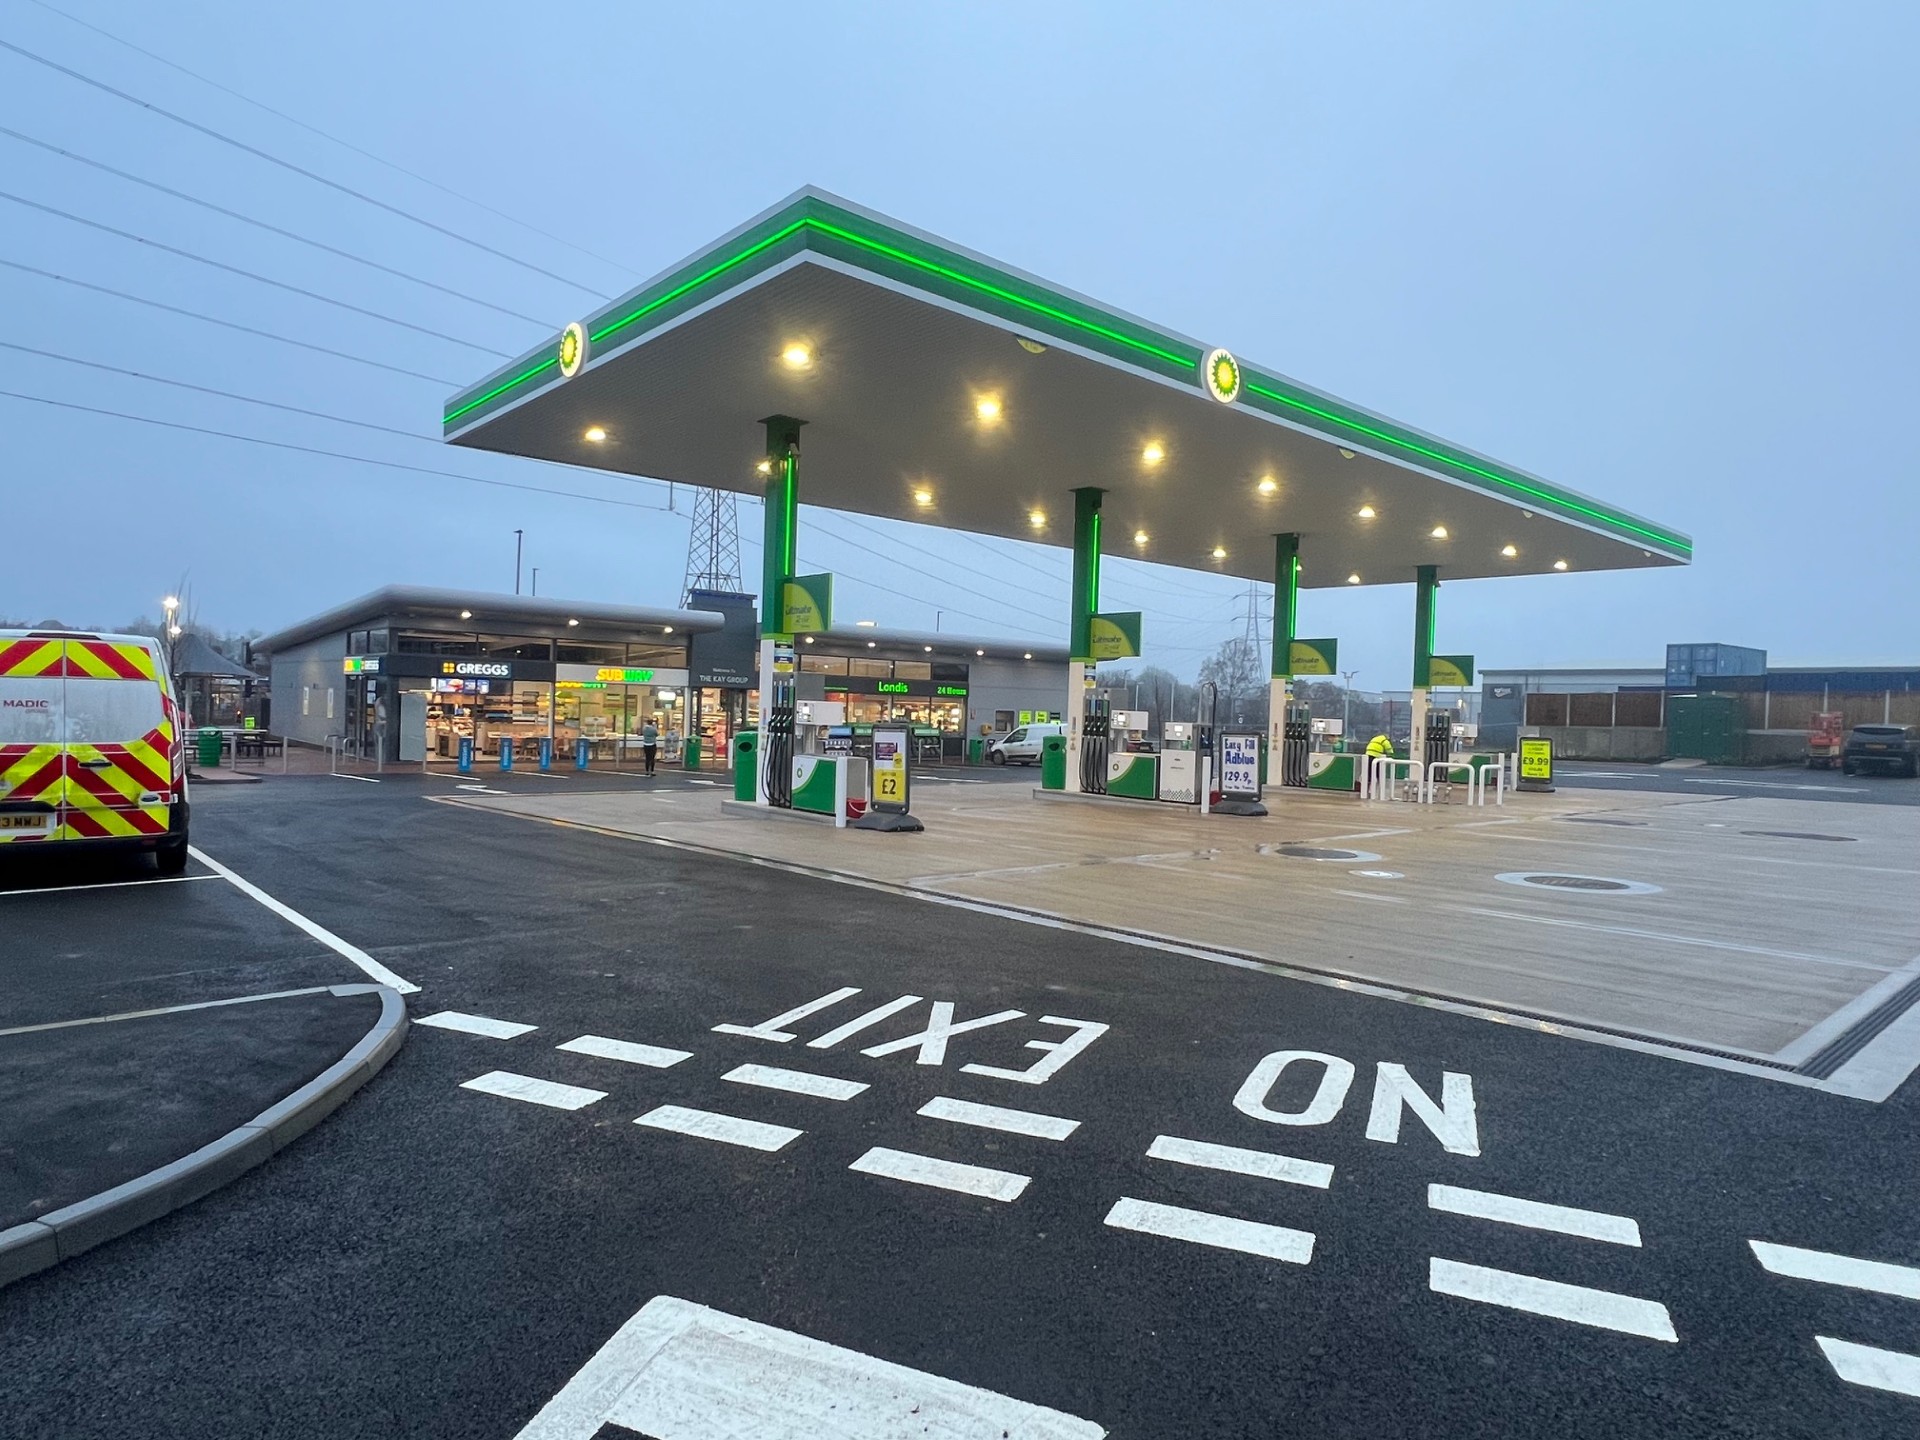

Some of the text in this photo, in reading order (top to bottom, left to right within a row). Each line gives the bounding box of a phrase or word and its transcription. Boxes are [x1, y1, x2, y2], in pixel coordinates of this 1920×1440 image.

[456, 662, 509, 676] GREGGS
[595, 668, 654, 682] SUBWAY
[700, 674, 712, 682] THE
[726, 676, 749, 684] GROUP
[878, 681, 909, 693] Londis
[937, 686, 946, 695] 24
[3, 699, 49, 708] MADIC
[1225, 738, 1255, 751] Easy Fill
[1225, 750, 1255, 765] Adblue
[881, 778, 897, 795] £2
[711, 986, 1481, 1157] NO EXIT
